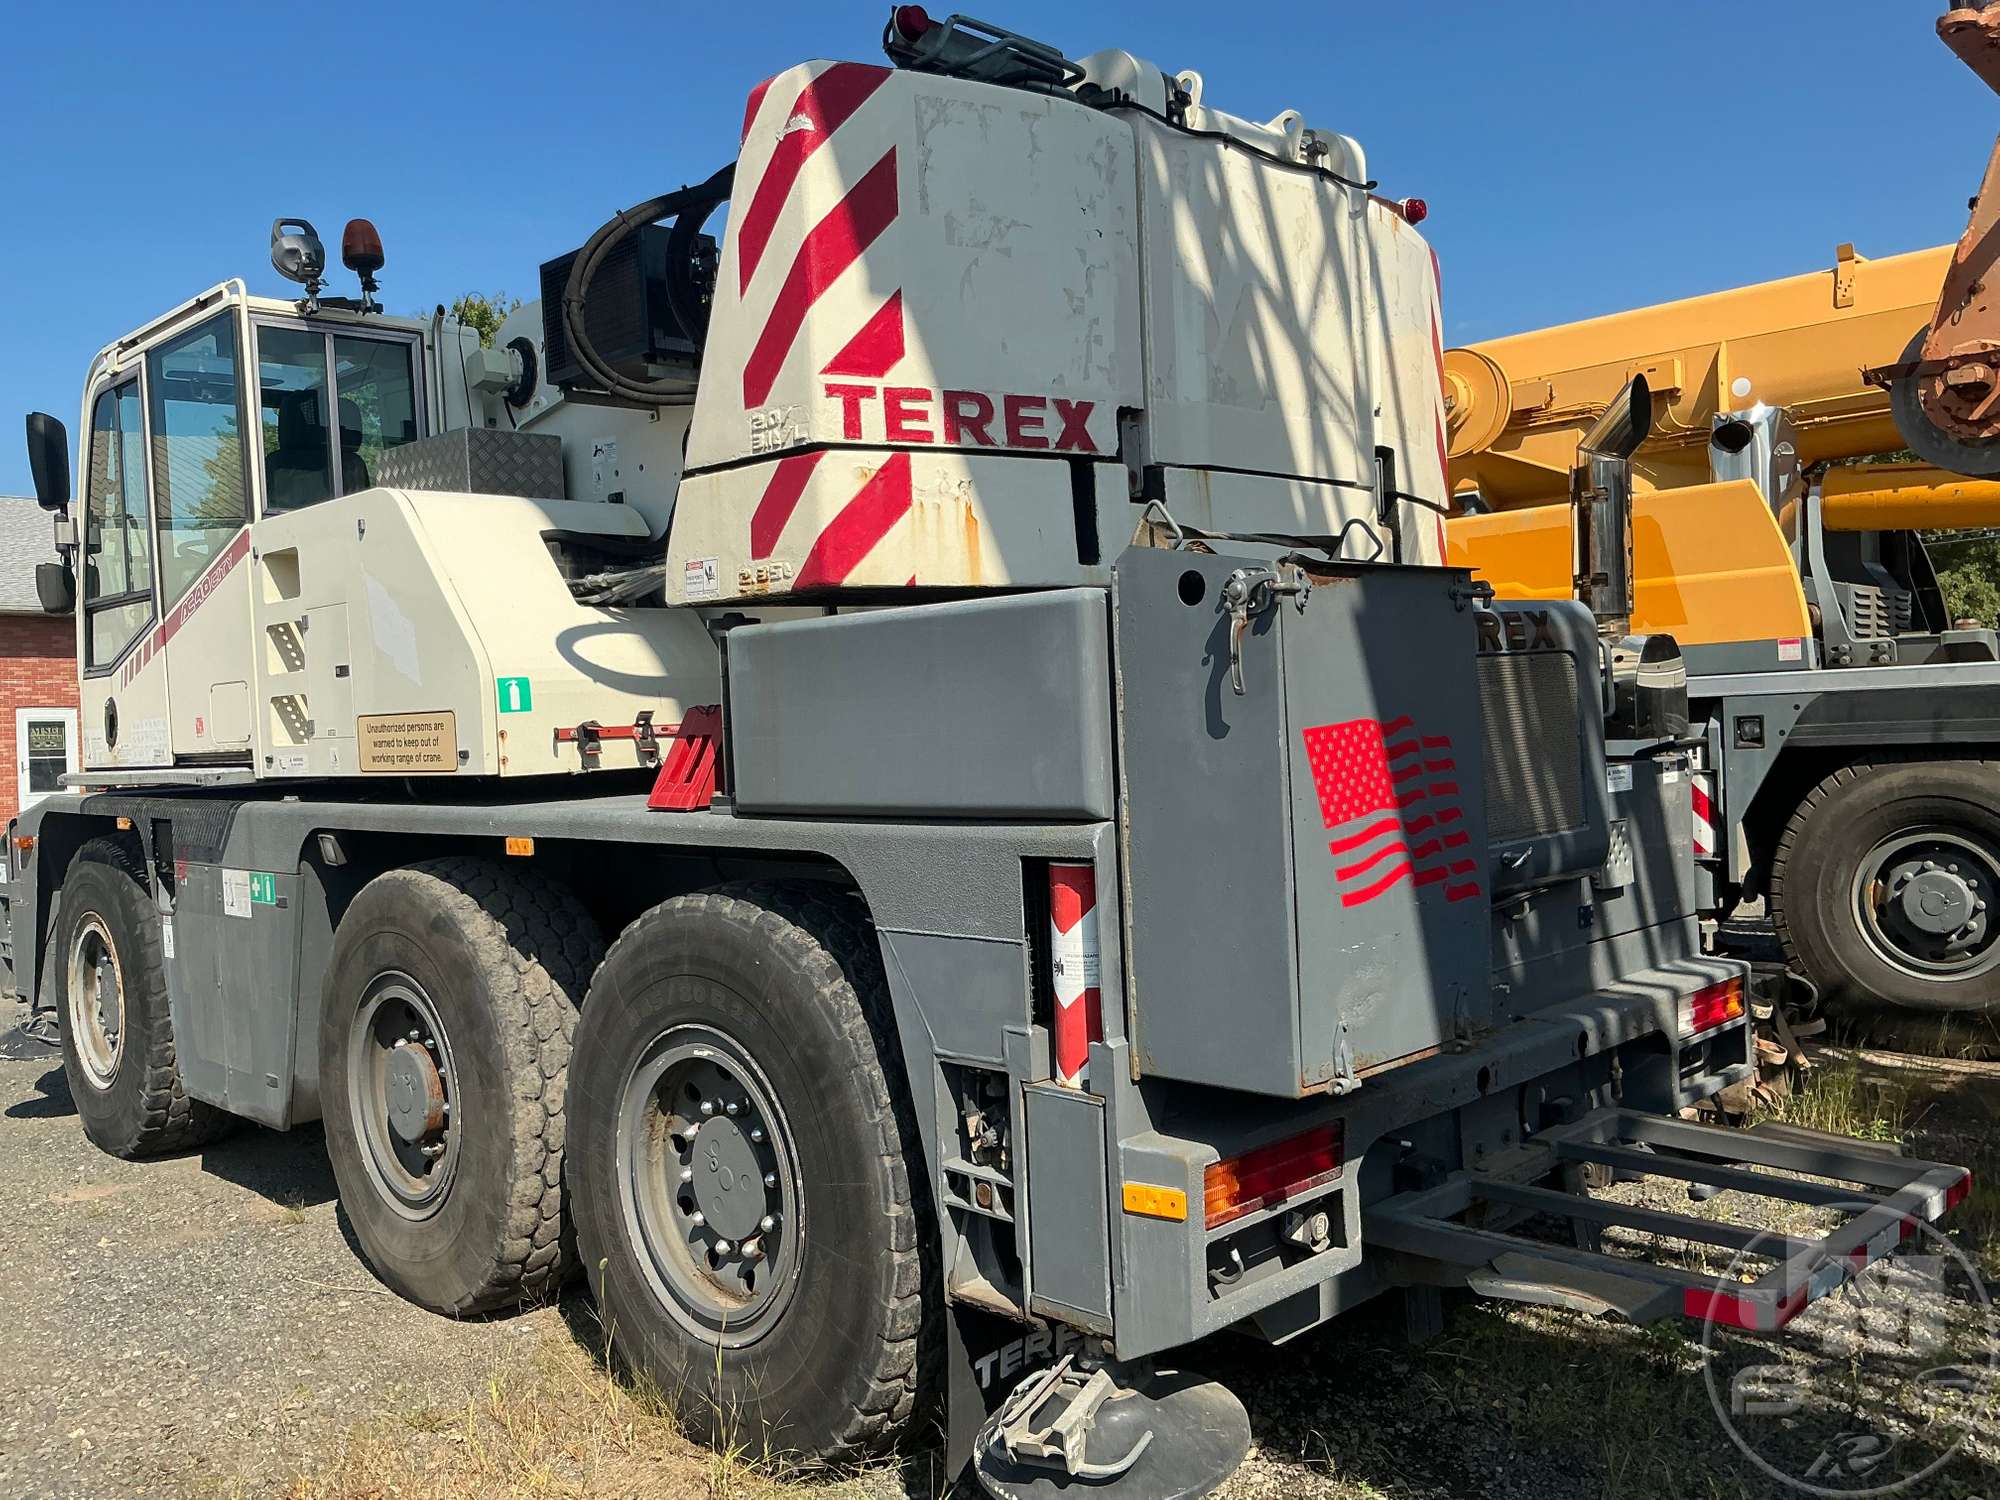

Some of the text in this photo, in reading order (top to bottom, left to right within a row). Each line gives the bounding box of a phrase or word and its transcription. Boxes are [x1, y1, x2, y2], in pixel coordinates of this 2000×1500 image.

[824, 382, 1098, 454] TEREX
[1474, 610, 1556, 651] REX
[366, 721, 445, 734] Unauthorized persons are
[373, 736, 439, 748] warned to keep out of
[371, 754, 395, 764] working
[396, 753, 414, 764] range
[414, 752, 422, 762] of
